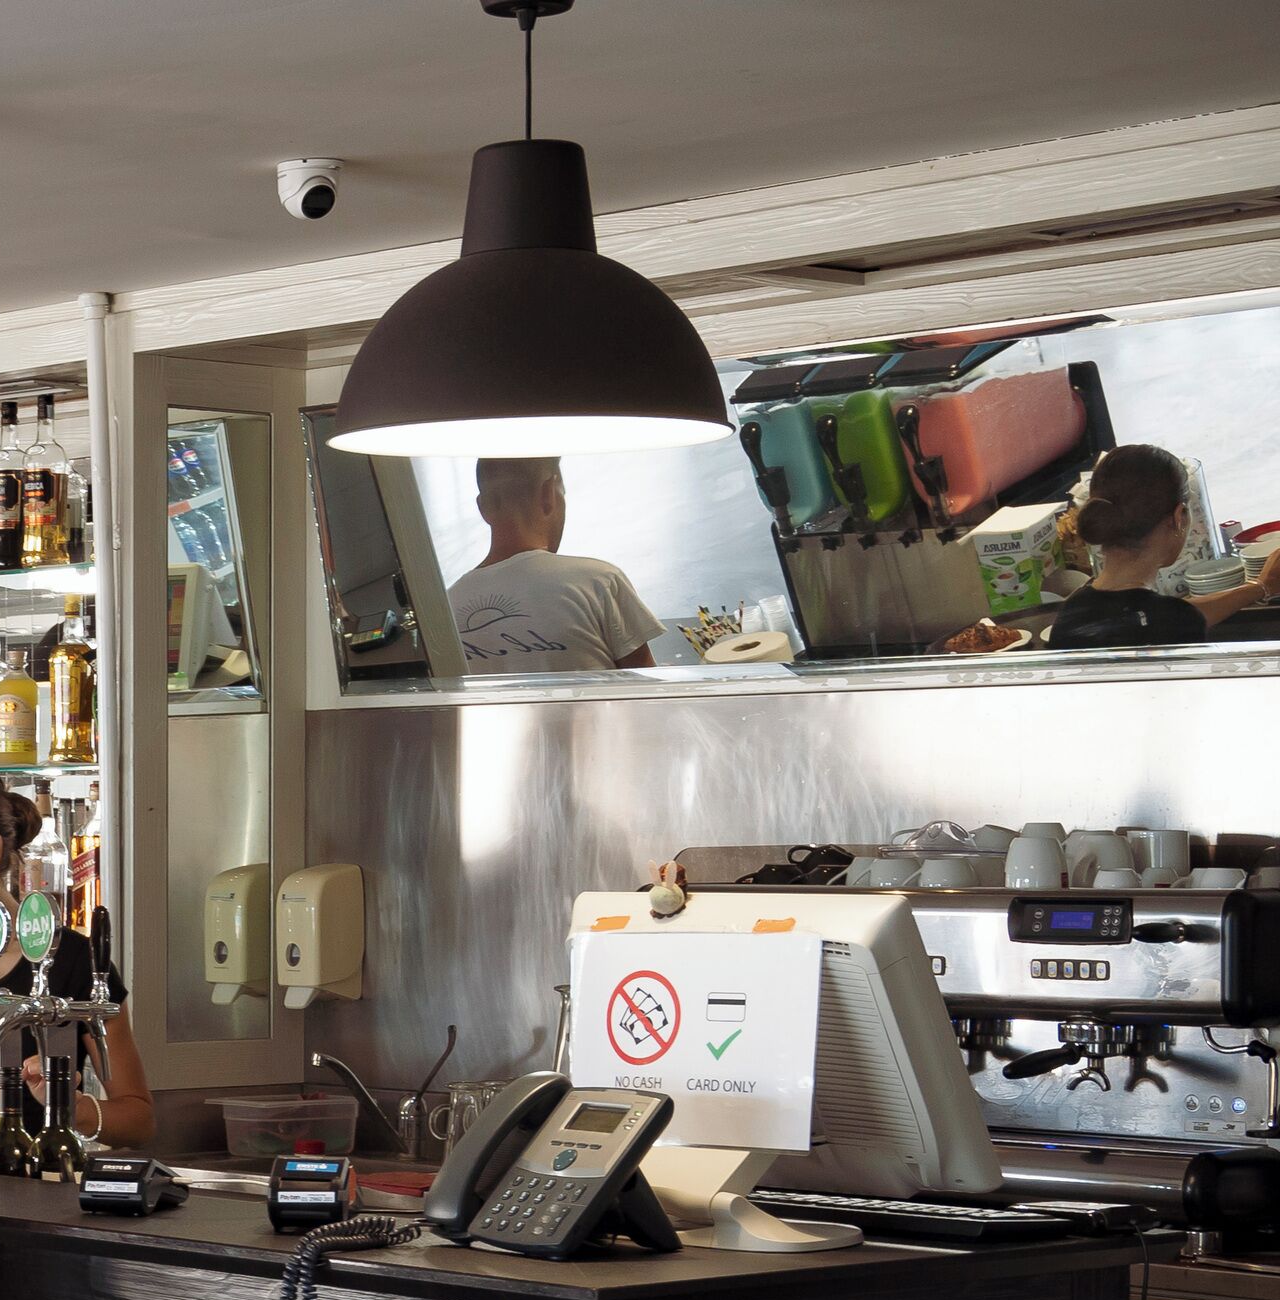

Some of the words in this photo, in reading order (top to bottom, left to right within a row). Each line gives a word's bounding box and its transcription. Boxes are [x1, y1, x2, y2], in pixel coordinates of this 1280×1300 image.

[21, 915, 50, 938] PAN
[614, 1075, 631, 1088] NO
[632, 1076, 663, 1089] CASH
[686, 1078, 720, 1092] CARD
[722, 1079, 757, 1093] ONLY
